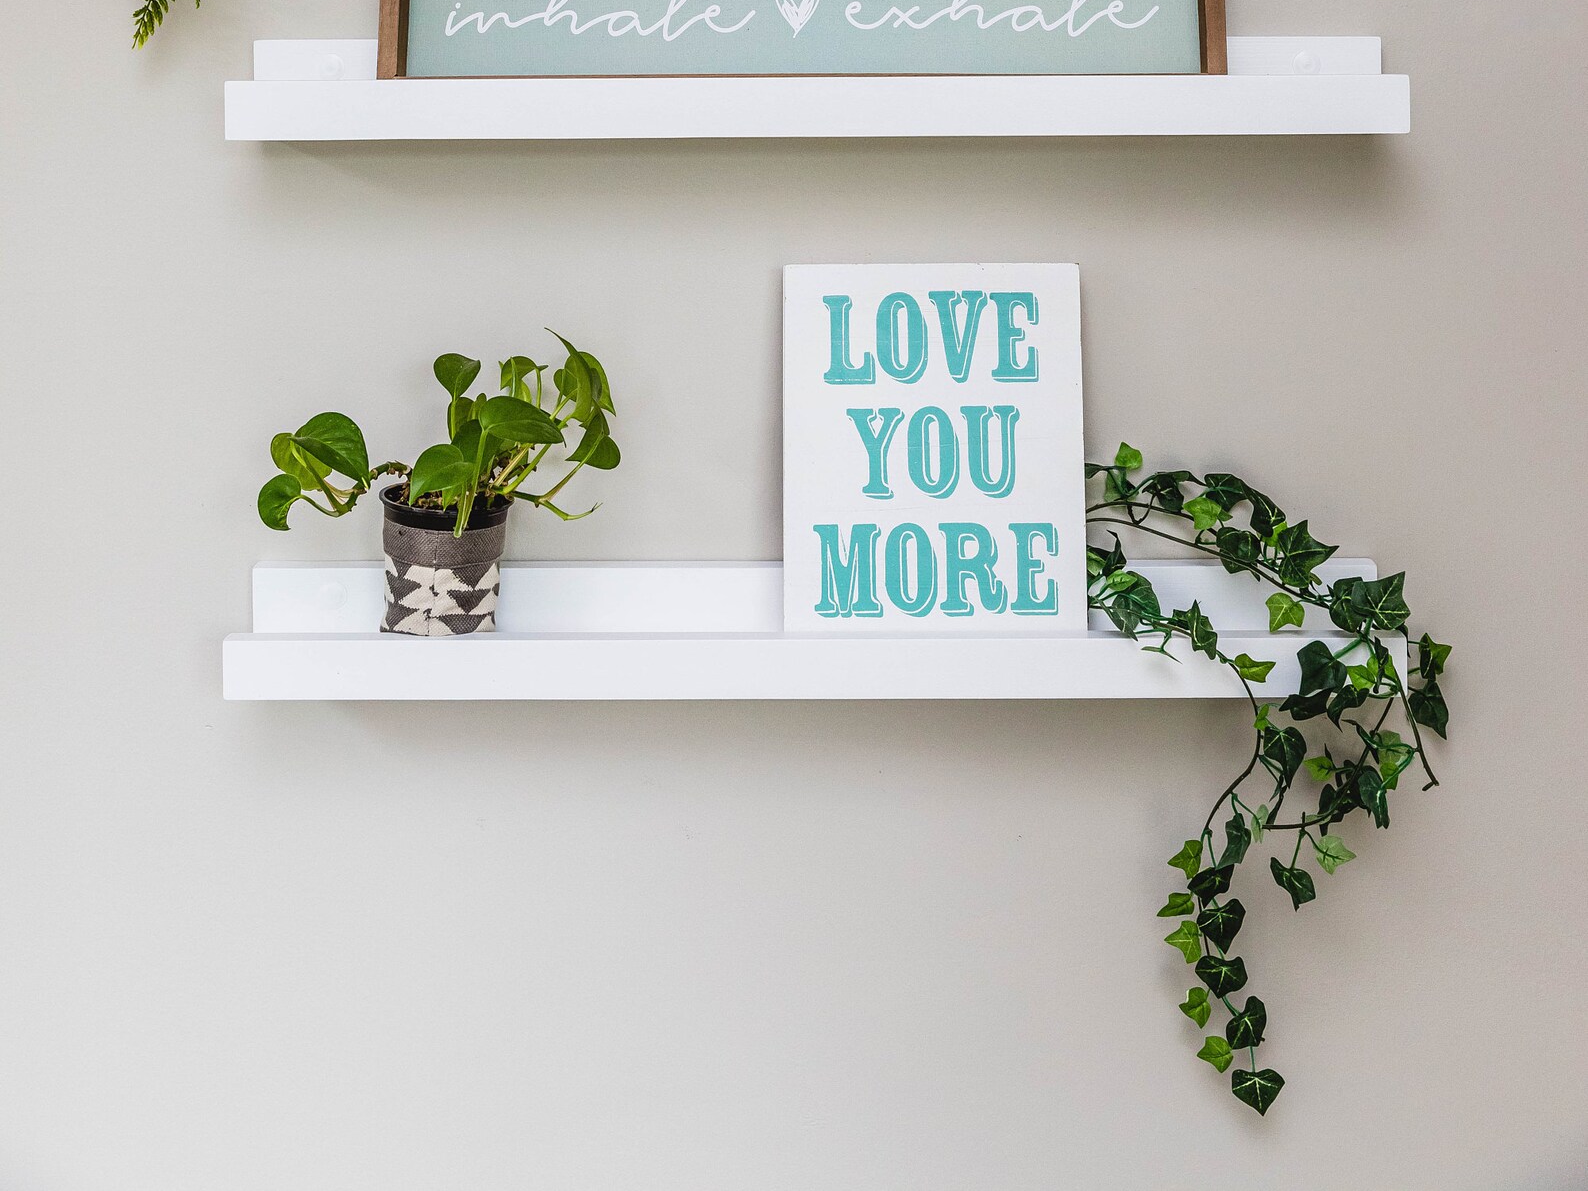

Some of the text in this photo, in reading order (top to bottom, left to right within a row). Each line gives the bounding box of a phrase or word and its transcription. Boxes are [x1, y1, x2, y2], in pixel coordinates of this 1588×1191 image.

[822, 290, 1040, 386] LOVE
[846, 404, 1021, 500] YOU
[812, 522, 1059, 618] MORE
